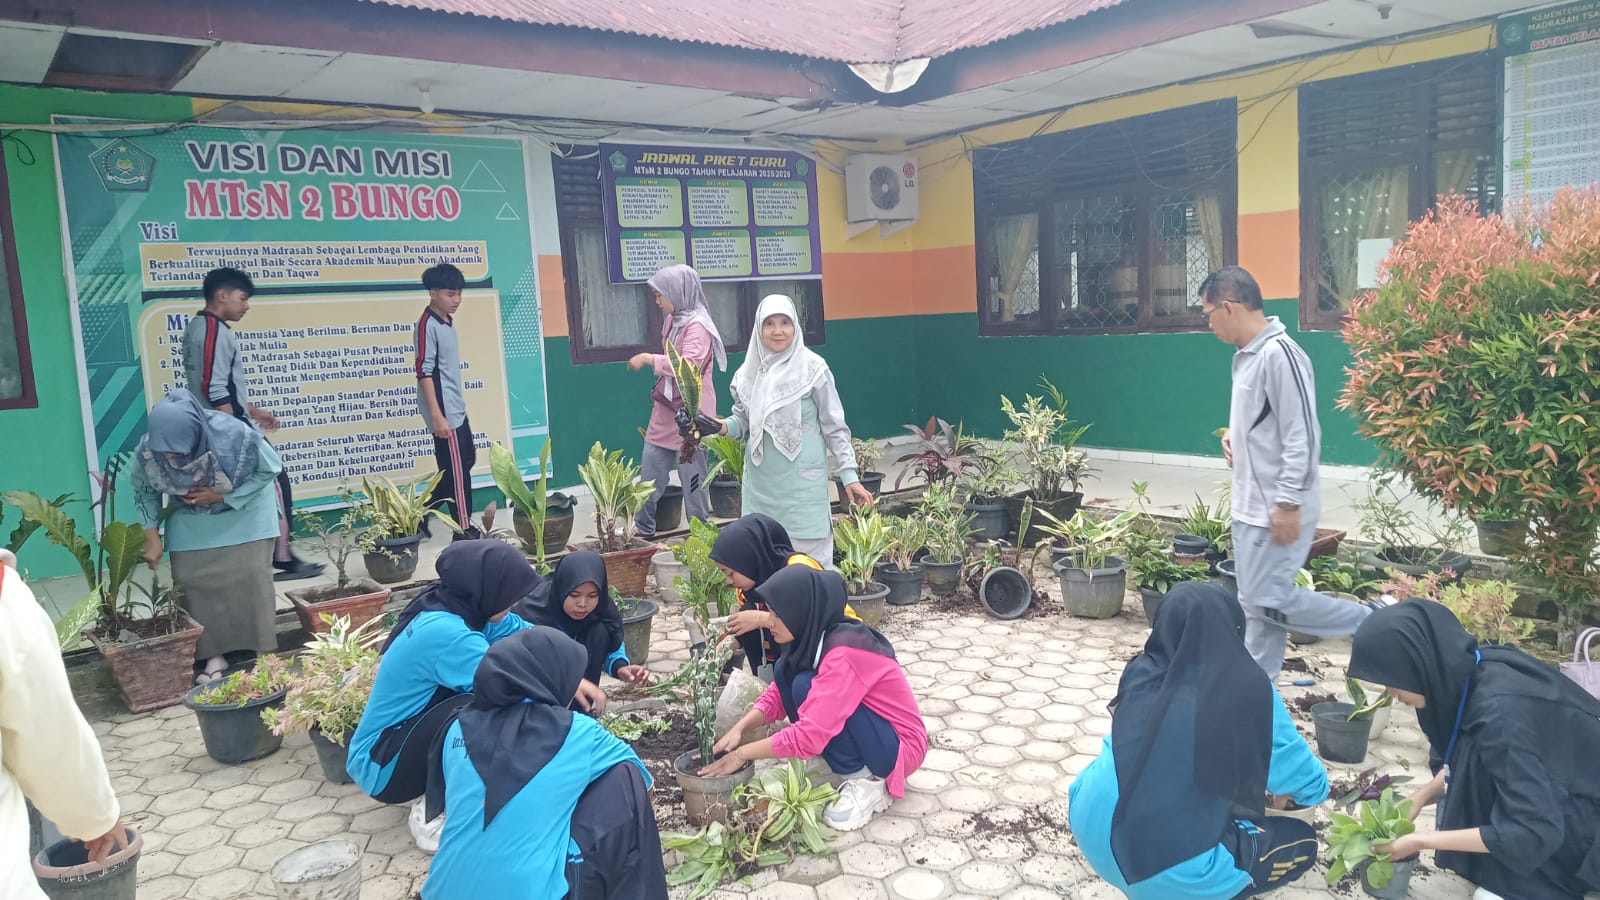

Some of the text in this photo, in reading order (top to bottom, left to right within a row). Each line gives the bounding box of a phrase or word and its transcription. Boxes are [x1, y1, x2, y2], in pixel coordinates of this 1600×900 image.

[1528, 16, 1580, 31] MADRASAH
[1531, 35, 1569, 50] DAFTAR
[188, 143, 450, 176] VISI DAN MISI
[637, 153, 787, 168] JADWAL PIKET GURU
[634, 166, 655, 175] MTsN
[657, 167, 662, 175] 2
[663, 167, 690, 176] BUNGO
[692, 168, 716, 176] TAHUN
[718, 168, 757, 177] PELAJARAN
[904, 180, 914, 188] LG
[188, 180, 459, 219] MTsN 2 BUNGO
[140, 222, 178, 240] Visi
[187, 244, 479, 258] Terwujudnya Madrasah Sebagai Lembaga Pendidikan Yang
[150, 255, 482, 269] Berkualitas Unggul Baik Secara Akademik Maupun Non Akademik
[150, 271, 207, 281] Terlandas
[263, 269, 283, 279] Dan
[286, 269, 319, 280] Taqwa
[167, 313, 190, 331] Mi
[158, 336, 166, 344] 1.
[235, 330, 278, 340] Manusia
[279, 329, 305, 339] Yang
[352, 323, 391, 334] Beriman
[393, 322, 411, 332] Dan
[240, 341, 288, 351] lak Mulia
[252, 351, 301, 362] Madrasah
[303, 348, 341, 359] Sebagai
[344, 346, 370, 356] Pusat
[373, 344, 414, 355] Peningka
[257, 364, 288, 374] Tenag
[290, 360, 317, 370] Didik
[319, 359, 339, 369] Dan
[341, 356, 405, 369] Kependidikan
[245, 377, 263, 386] swa
[267, 373, 298, 384] Untuk
[300, 368, 380, 382] Mengembangkan
[383, 365, 416, 375] Potensi
[248, 385, 300, 397] Dan Minat
[283, 394, 335, 407] Depalapan
[338, 391, 374, 401] Standar
[377, 386, 417, 397] Pendidik
[464, 381, 483, 390] Baik
[271, 407, 310, 418] kungan
[312, 404, 336, 415] Yang
[369, 399, 398, 409] Bersih
[401, 397, 418, 407] Dan
[276, 408, 421, 429] daran Atas Aturan Dan Kedispl
[275, 441, 314, 452] sadaran
[316, 436, 354, 447] Seluruh
[356, 432, 386, 443] Warga
[316, 461, 335, 470] Dan
[338, 452, 405, 466] Kekeluargaan)
[302, 470, 346, 483] Kondusif
[348, 466, 367, 476] Dan
[369, 460, 416, 474] Konduktif
